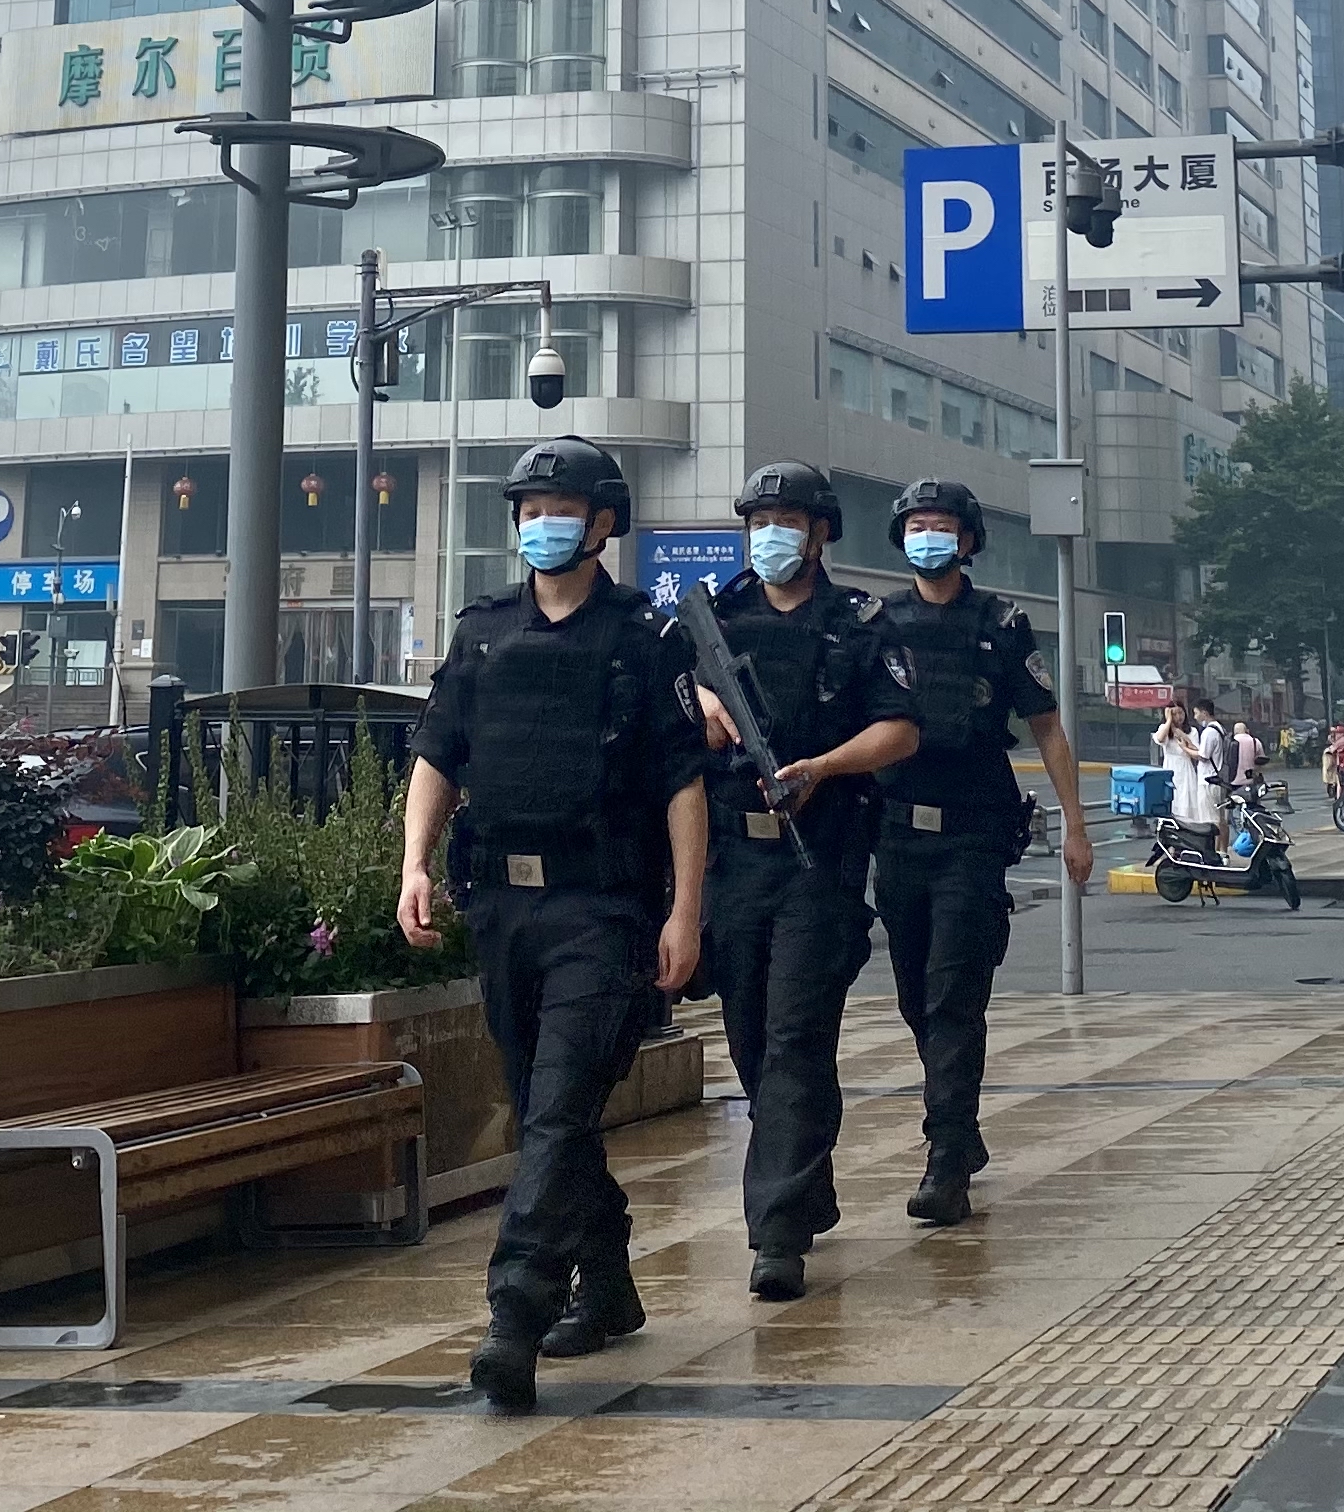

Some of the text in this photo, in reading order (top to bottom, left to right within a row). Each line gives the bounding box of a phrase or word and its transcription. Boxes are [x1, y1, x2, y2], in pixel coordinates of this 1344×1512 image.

[922, 181, 995, 299] P
[34, 320, 408, 371] 戴氏名望学
[11, 569, 95, 596] 停车场
